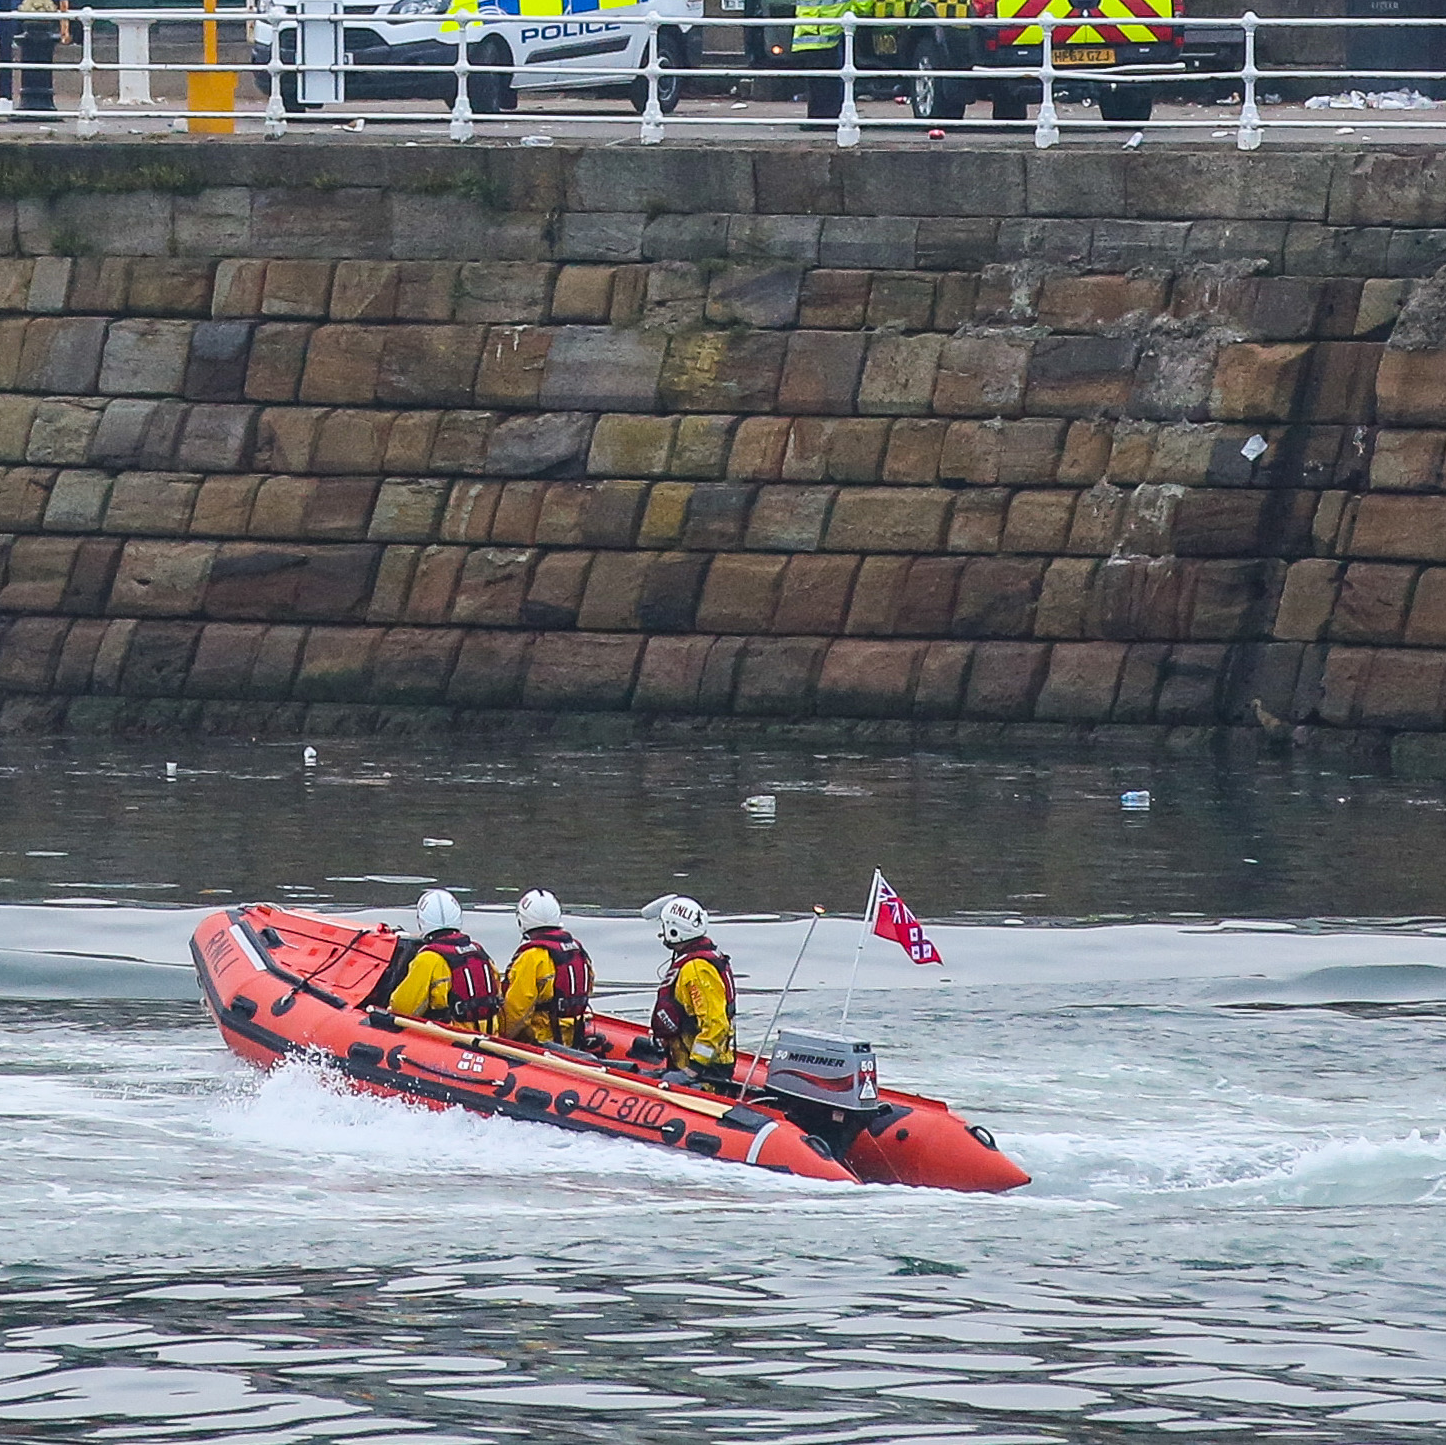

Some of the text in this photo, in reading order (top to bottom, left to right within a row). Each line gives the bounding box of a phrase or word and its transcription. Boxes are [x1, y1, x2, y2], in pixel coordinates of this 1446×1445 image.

[669, 903, 693, 920] RNLI
[205, 929, 239, 979] RNLI
[775, 1050, 846, 1068] 50 MARINER
[860, 1060, 874, 1072] 50
[586, 1087, 665, 1126] D-810
